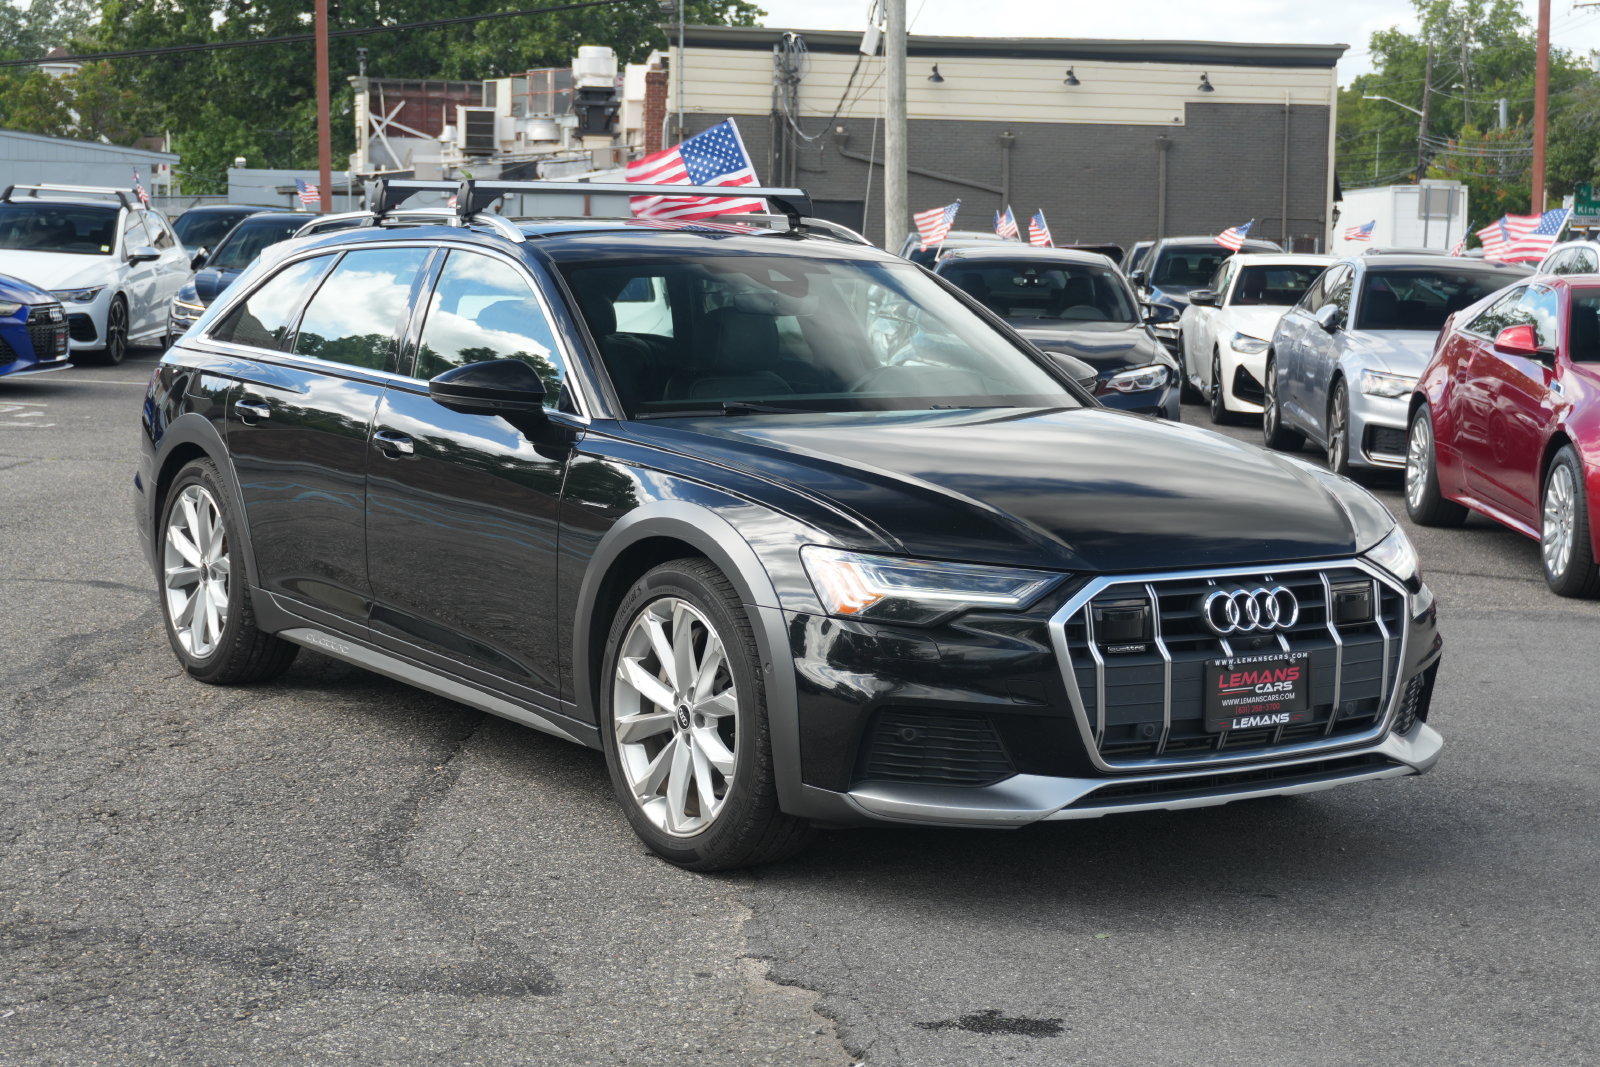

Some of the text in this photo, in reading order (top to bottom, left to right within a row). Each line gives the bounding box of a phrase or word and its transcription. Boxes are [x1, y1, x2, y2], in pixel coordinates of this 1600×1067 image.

[1218, 666, 1300, 688] LEMANS
[1255, 681, 1293, 693] CARS
[1222, 692, 1295, 706] WWW.LEMANSCARS.COM
[1232, 713, 1290, 729] LEMANS
